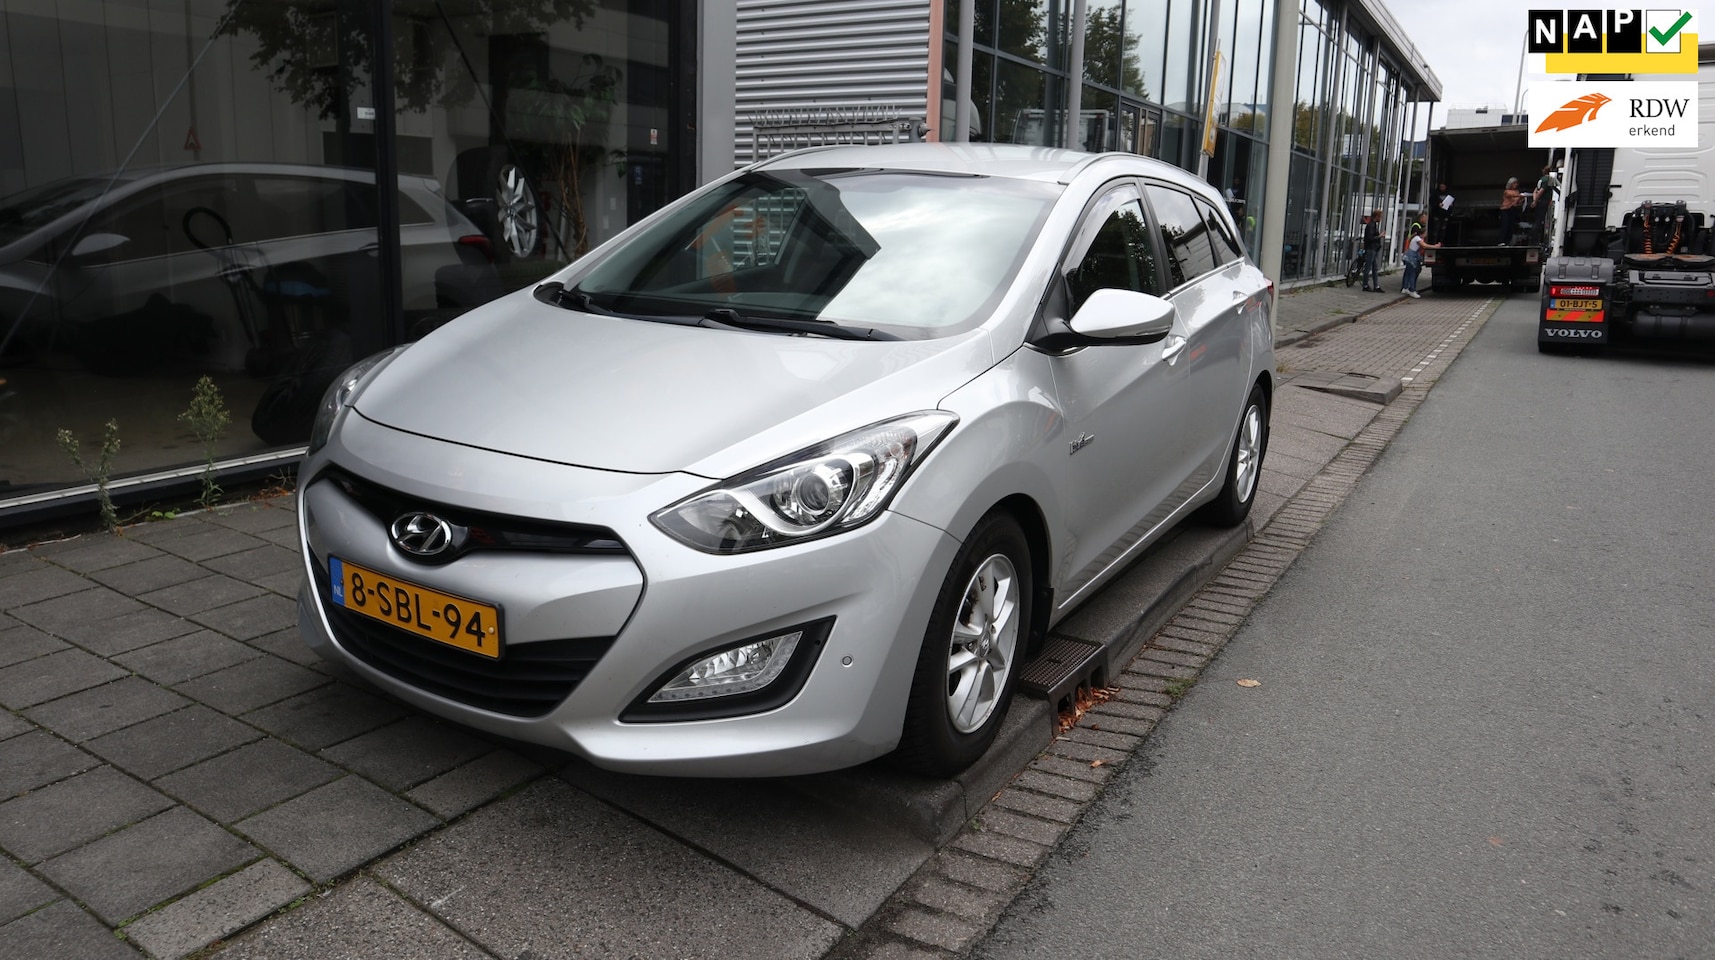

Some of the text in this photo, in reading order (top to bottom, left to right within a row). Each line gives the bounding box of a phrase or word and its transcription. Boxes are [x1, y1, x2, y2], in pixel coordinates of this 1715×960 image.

[1559, 299, 1598, 309] 01-BJT-5
[1544, 328, 1603, 339] VOLVO
[351, 572, 486, 648] 8-SBL-94
